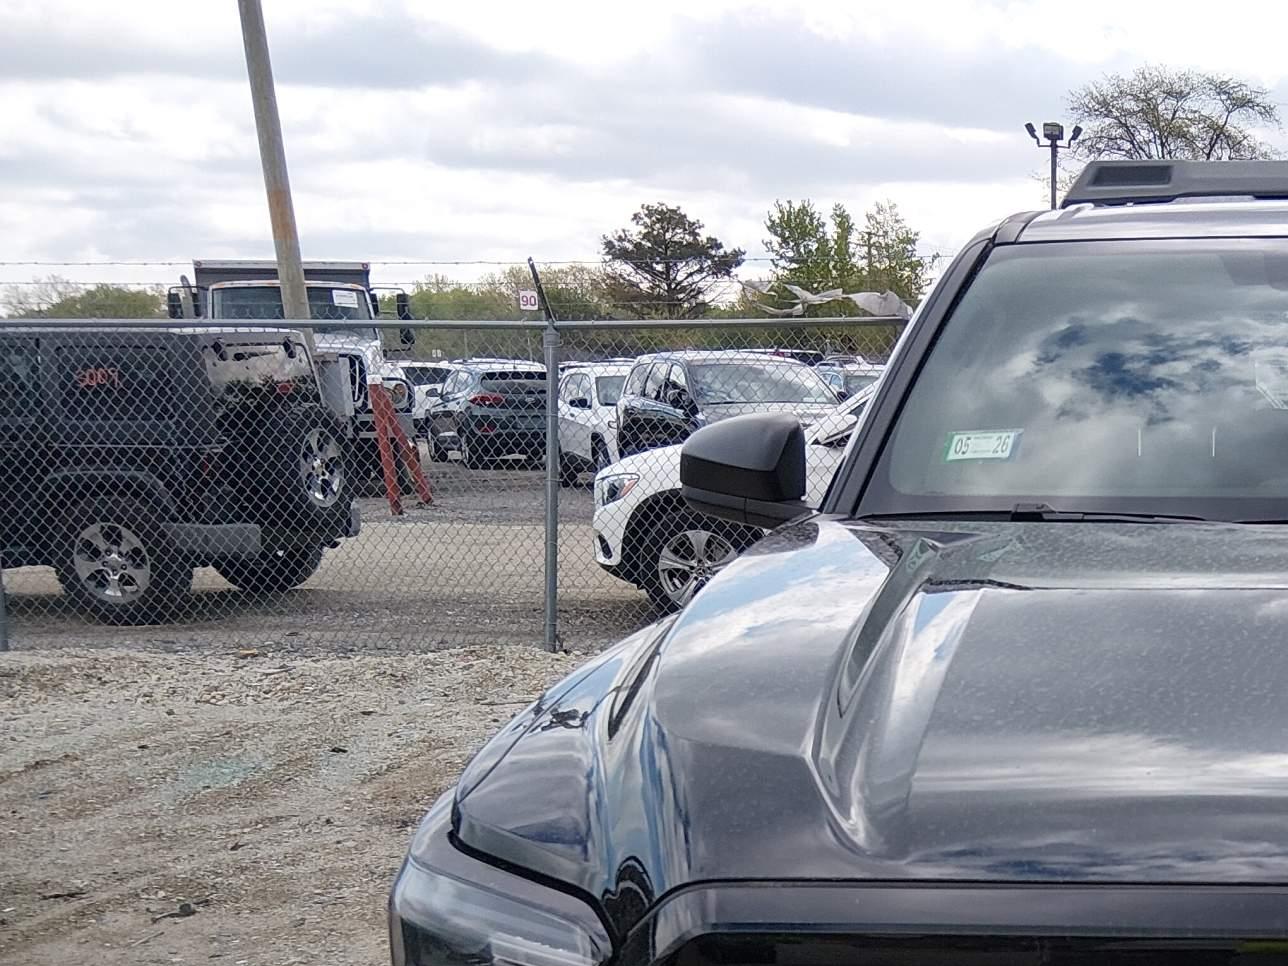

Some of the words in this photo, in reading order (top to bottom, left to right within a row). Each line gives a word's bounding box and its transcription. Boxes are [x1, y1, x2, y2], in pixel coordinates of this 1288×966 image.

[521, 295, 537, 307] 90
[954, 436, 971, 455] 05
[992, 434, 1011, 454] 26
